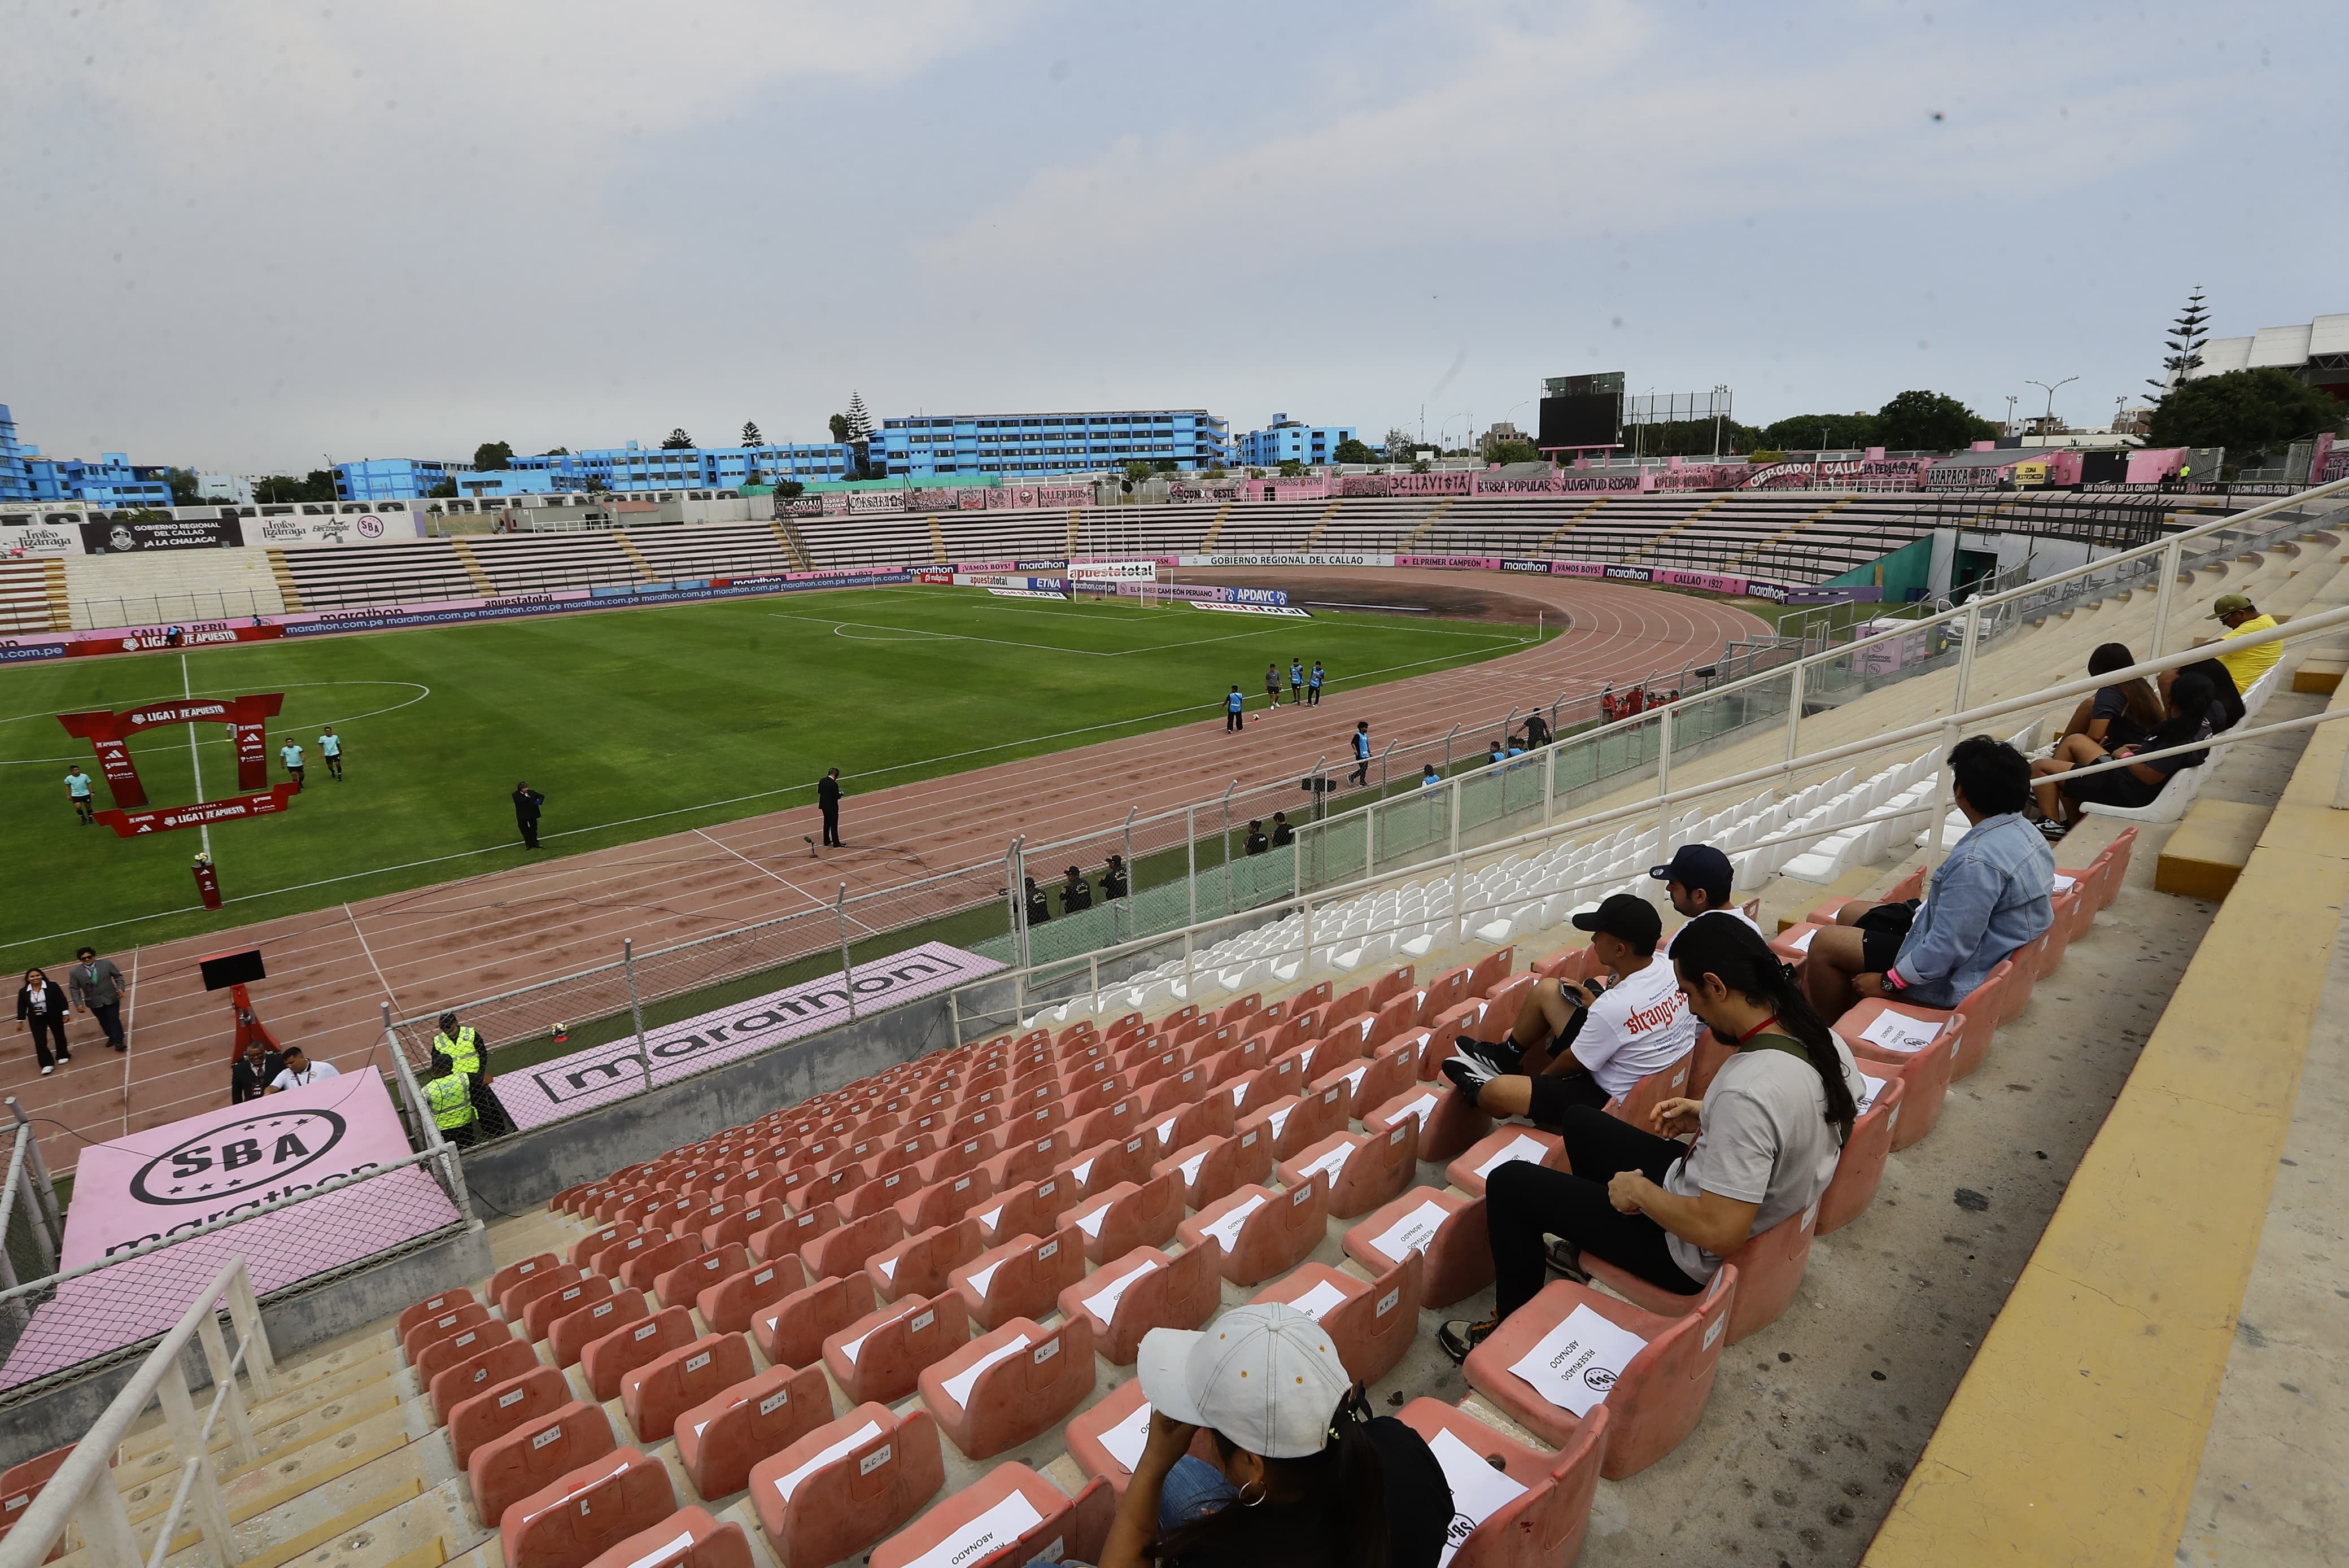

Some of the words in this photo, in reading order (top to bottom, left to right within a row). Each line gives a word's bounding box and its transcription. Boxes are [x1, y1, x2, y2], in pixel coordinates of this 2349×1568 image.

[1508, 479, 1551, 492] POPULAR
[1562, 479, 1608, 491] JUVENTUD
[1214, 489, 1236, 498] OESTE
[361, 522, 380, 534] SBA
[170, 536, 216, 545] CHALACA!
[1019, 561, 1065, 570] marathon
[1211, 556, 1257, 564] GOBIERNO
[1260, 556, 1306, 564] REGIONAL
[1504, 561, 1547, 571] marathon
[907, 565, 954, 575] marathon
[1069, 565, 1153, 579] apuestatotal
[1581, 565, 1600, 574] BOYS!
[1606, 567, 1648, 580] marathon
[781, 578, 845, 589] marathon.com.pe
[847, 574, 911, 585] marathon.com.pe
[970, 576, 1008, 586] apuestatotal
[1036, 578, 1061, 588] ETNA
[1674, 574, 1701, 586] CALLAO
[1708, 578, 1723, 589] 1927
[641, 589, 711, 602] marathon.com.pe
[713, 583, 779, 596] marathon.com.pe
[1185, 588, 1213, 597] PERUANO
[1237, 588, 1274, 602] APDAYC
[1749, 583, 1784, 600] marathon
[484, 593, 552, 608] apuestatotal
[564, 595, 639, 609] marathon.com.pe
[479, 602, 561, 617] marathon.com.pe
[1195, 602, 1304, 615] apuestatotal
[386, 610, 477, 625] marathon.com.pe
[286, 618, 384, 634] marathon.com.pe
[142, 634, 172, 649] LIGA
[184, 633, 196, 645] TE
[196, 630, 236, 643] APUESTO
[147, 710, 176, 722] LIGA1
[181, 709, 190, 718] TE
[191, 705, 224, 716] APUESTO
[177, 812, 204, 823] LIGA1
[215, 806, 245, 817] APUESTO
[1623, 997, 1679, 1035] strange
[569, 959, 938, 1089] marathon
[172, 1133, 309, 1179] SBA
[1400, 1222, 1424, 1242] ABONADO
[1407, 1229, 1435, 1250] RESERVADO
[1549, 1339, 1579, 1369] ABONADO
[1561, 1348, 1596, 1381] RESERVADO
[1587, 1374, 1617, 1385] SBA
[951, 1531, 994, 1565] ABONADO
